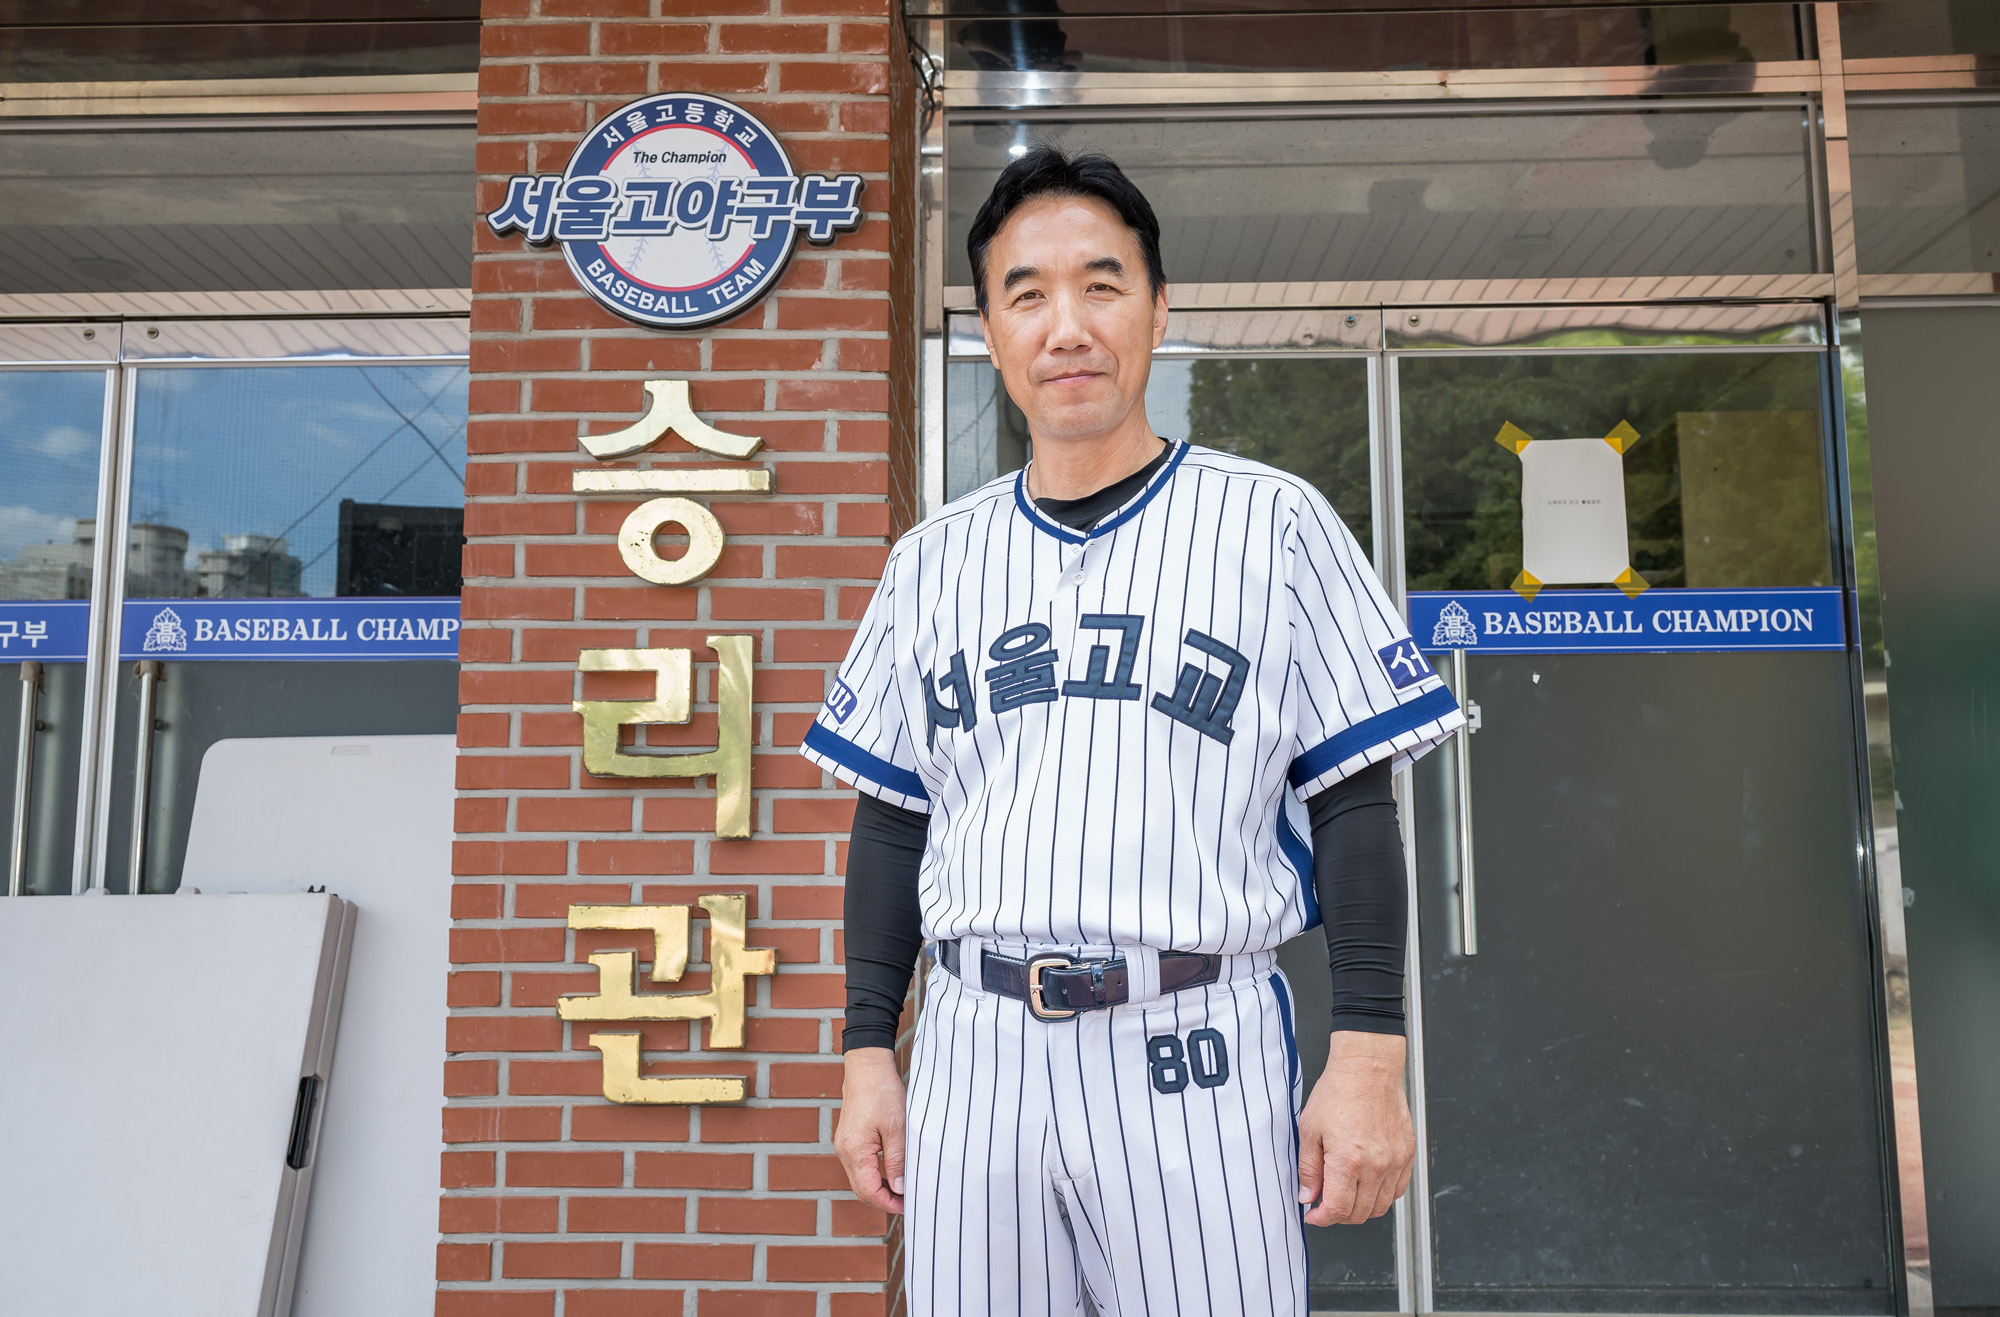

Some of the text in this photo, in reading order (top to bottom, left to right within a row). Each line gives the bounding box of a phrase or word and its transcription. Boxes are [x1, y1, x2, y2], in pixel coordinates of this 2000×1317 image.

[602, 103, 759, 149] 서울고등학교
[633, 150, 727, 165] The Champion
[488, 176, 863, 240] 서울고야구부
[586, 257, 766, 314] BASEBALL TEAM
[193, 617, 460, 642] BASEBALL CHAMP
[1483, 608, 1814, 635] BASEBALL CHAMPION
[1389, 640, 1430, 678] 서
[827, 680, 853, 719] UL
[922, 612, 1252, 757] 서울고교
[556, 379, 777, 1106] 승리관
[1147, 1027, 1230, 1095] 80
